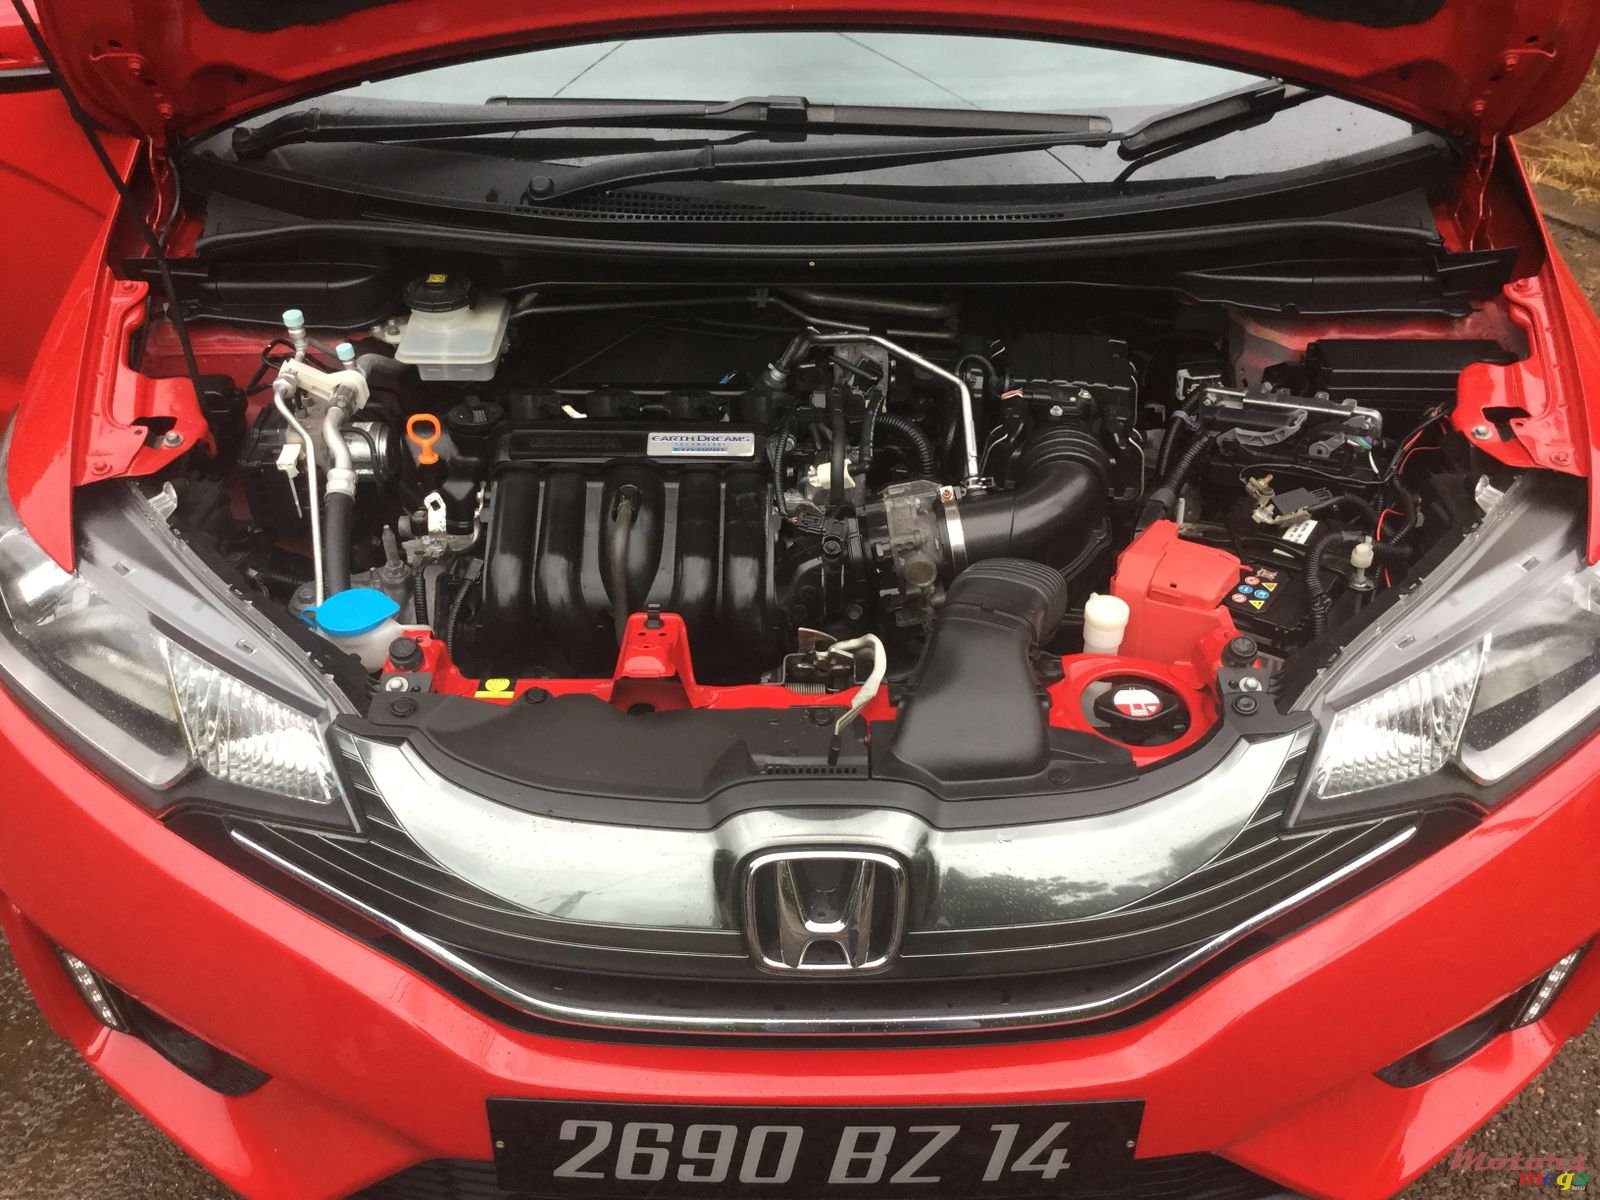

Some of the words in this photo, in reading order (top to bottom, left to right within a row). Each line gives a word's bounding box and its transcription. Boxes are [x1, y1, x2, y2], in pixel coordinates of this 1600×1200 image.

[552, 1119, 805, 1184] 2690
[826, 1125, 962, 1184] BZ
[982, 1121, 1072, 1181] 14
